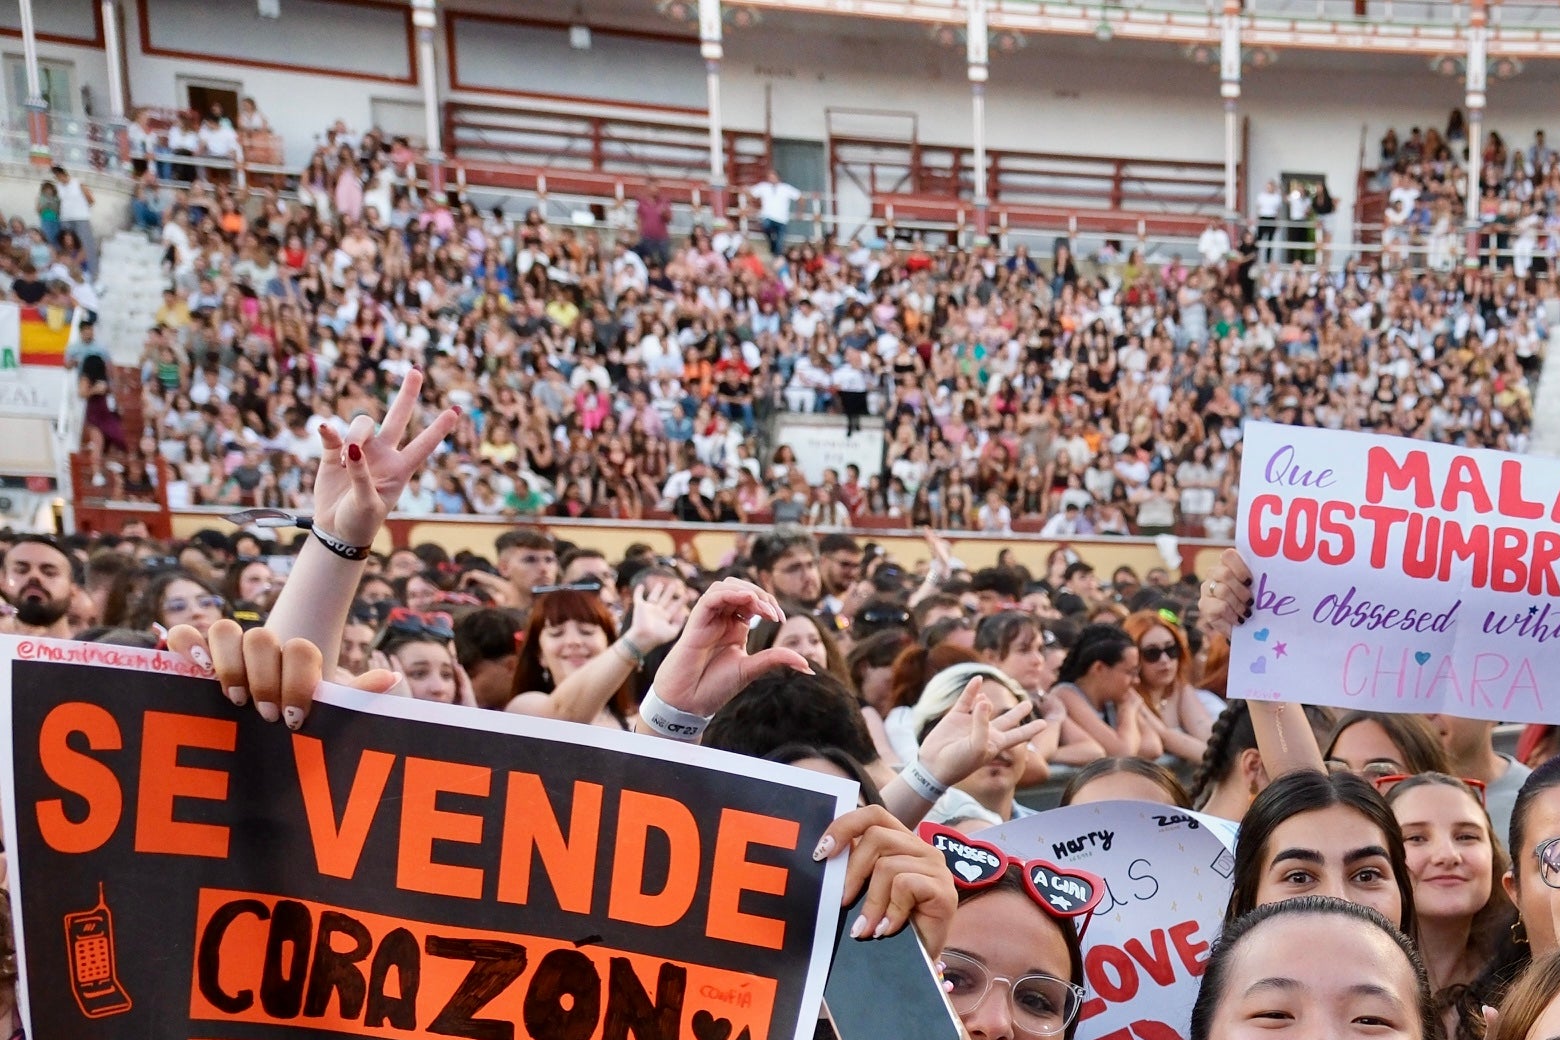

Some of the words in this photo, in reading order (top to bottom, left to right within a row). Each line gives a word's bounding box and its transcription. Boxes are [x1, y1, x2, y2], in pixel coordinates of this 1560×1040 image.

[1265, 445, 1337, 488] Que
[1256, 573, 1300, 616] be
[35, 702, 237, 858] SE
[292, 734, 800, 950] VENDE
[935, 835, 947, 851] I
[1052, 829, 1115, 860] Harry
[1034, 871, 1048, 887] A
